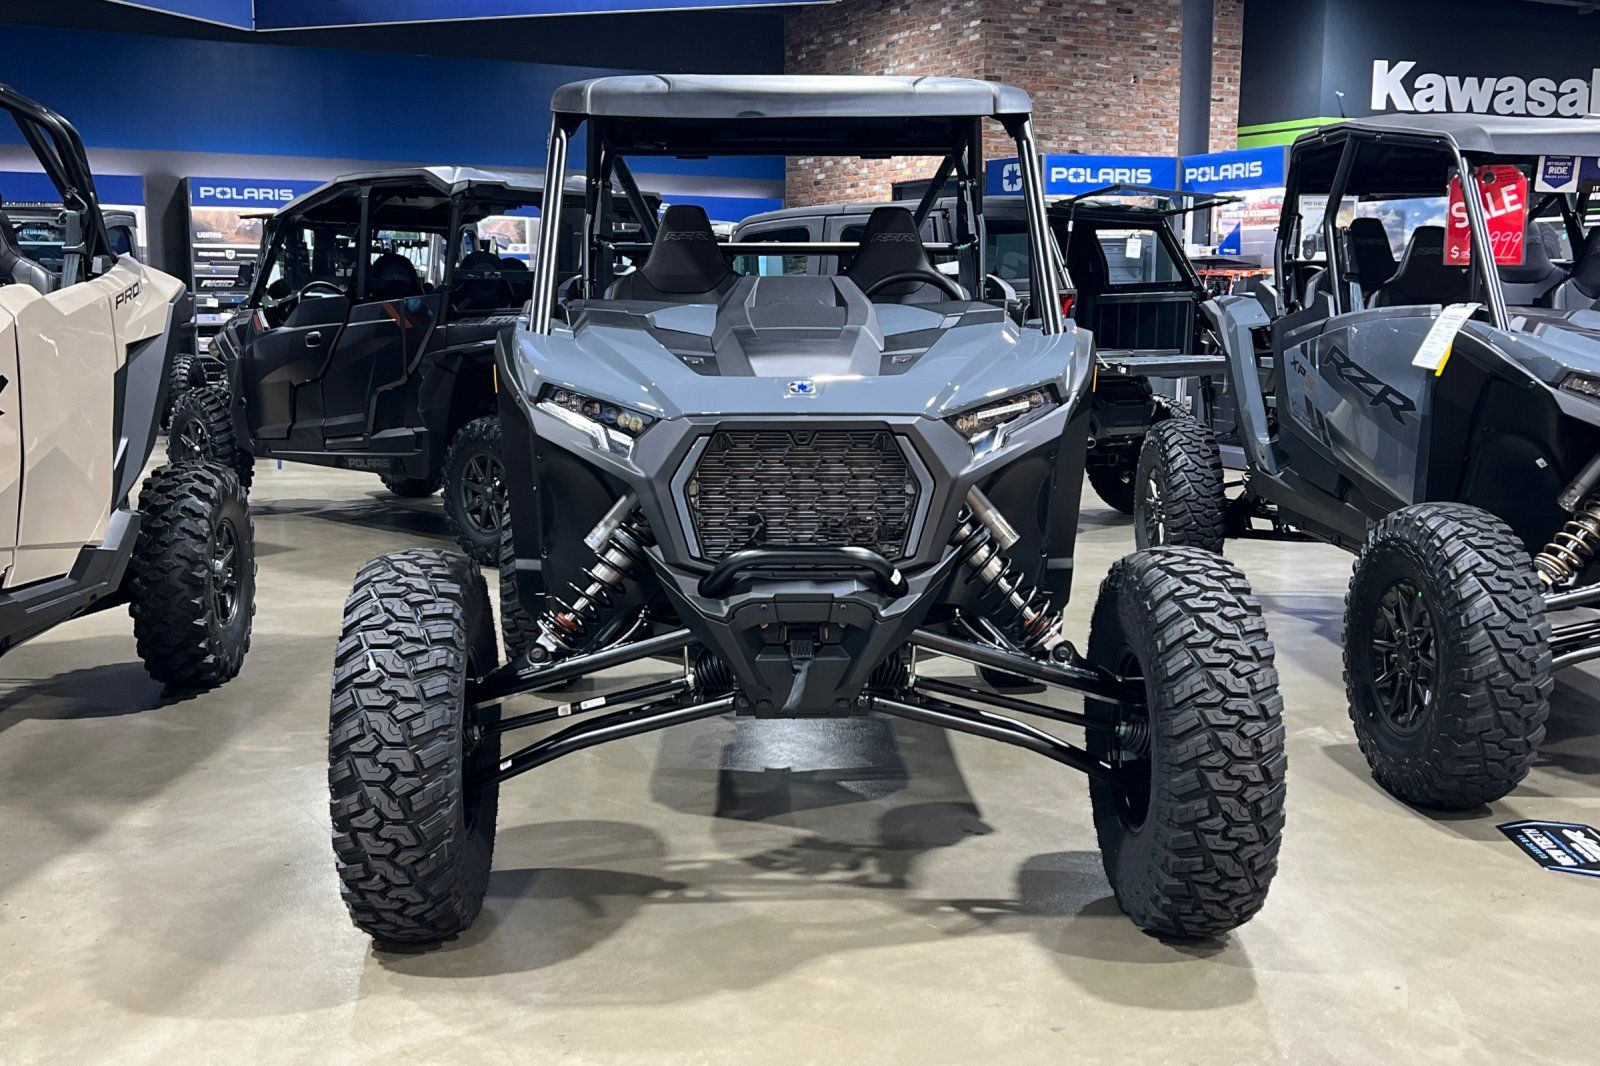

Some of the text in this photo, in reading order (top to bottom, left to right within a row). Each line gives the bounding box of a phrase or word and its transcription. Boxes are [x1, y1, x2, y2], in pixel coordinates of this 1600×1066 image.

[1371, 60, 1600, 117] Kawasa
[1051, 167, 1152, 184] POLARIS
[1185, 160, 1263, 184] POLARIS
[1548, 166, 1568, 175] RIDE
[199, 186, 295, 201] POLARIS
[1451, 183, 1523, 228] SLE
[663, 231, 709, 241] RZR
[871, 232, 914, 242] RZR
[200, 279, 236, 288] RIGID
[115, 281, 140, 310] PRO
[1321, 344, 1417, 427] RZR
[348, 457, 391, 469] POLARIS
